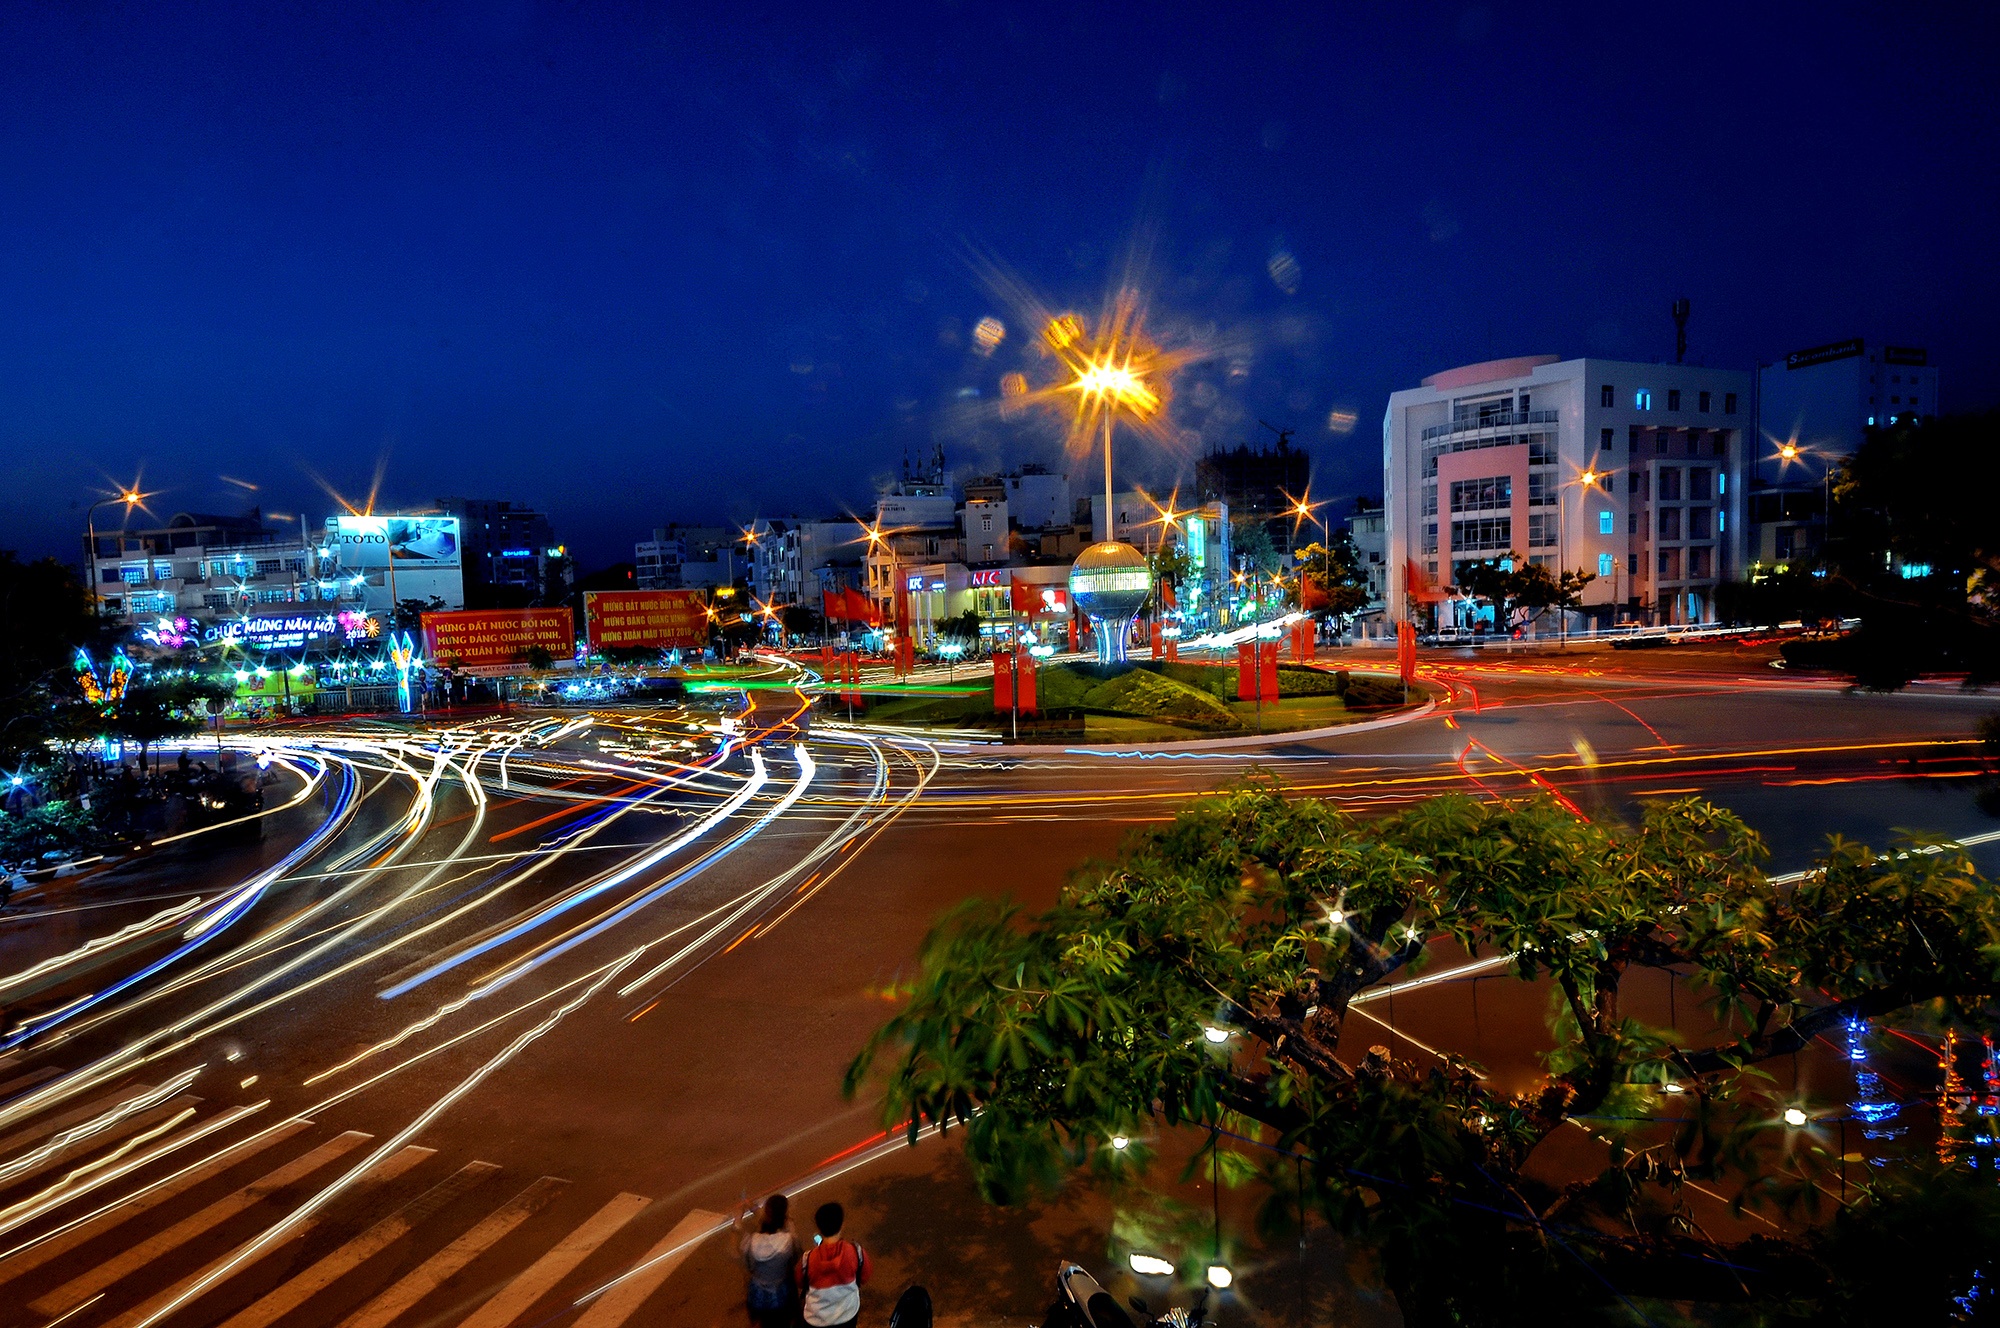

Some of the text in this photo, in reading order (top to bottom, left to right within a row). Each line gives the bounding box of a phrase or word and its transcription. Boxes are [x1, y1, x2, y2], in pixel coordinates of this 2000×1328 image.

[1789, 343, 1857, 365] Sacombank
[341, 535, 386, 544] TOTO
[909, 577, 922, 590] KFC
[972, 571, 1001, 585] KFC
[204, 621, 241, 642] CHÚC
[285, 617, 311, 631] NĂM
[436, 617, 560, 633] MỪNG ĐẤT NƯỚC ĐỔI MỚI,
[346, 629, 367, 639] 2018
[437, 631, 561, 646] MỪNG ĐẢNG QUANG VINH,
[433, 646, 463, 658] MỪNG
[465, 645, 493, 656] XUÂN
[496, 645, 517, 655] MẬU
[545, 643, 567, 652] 2018
